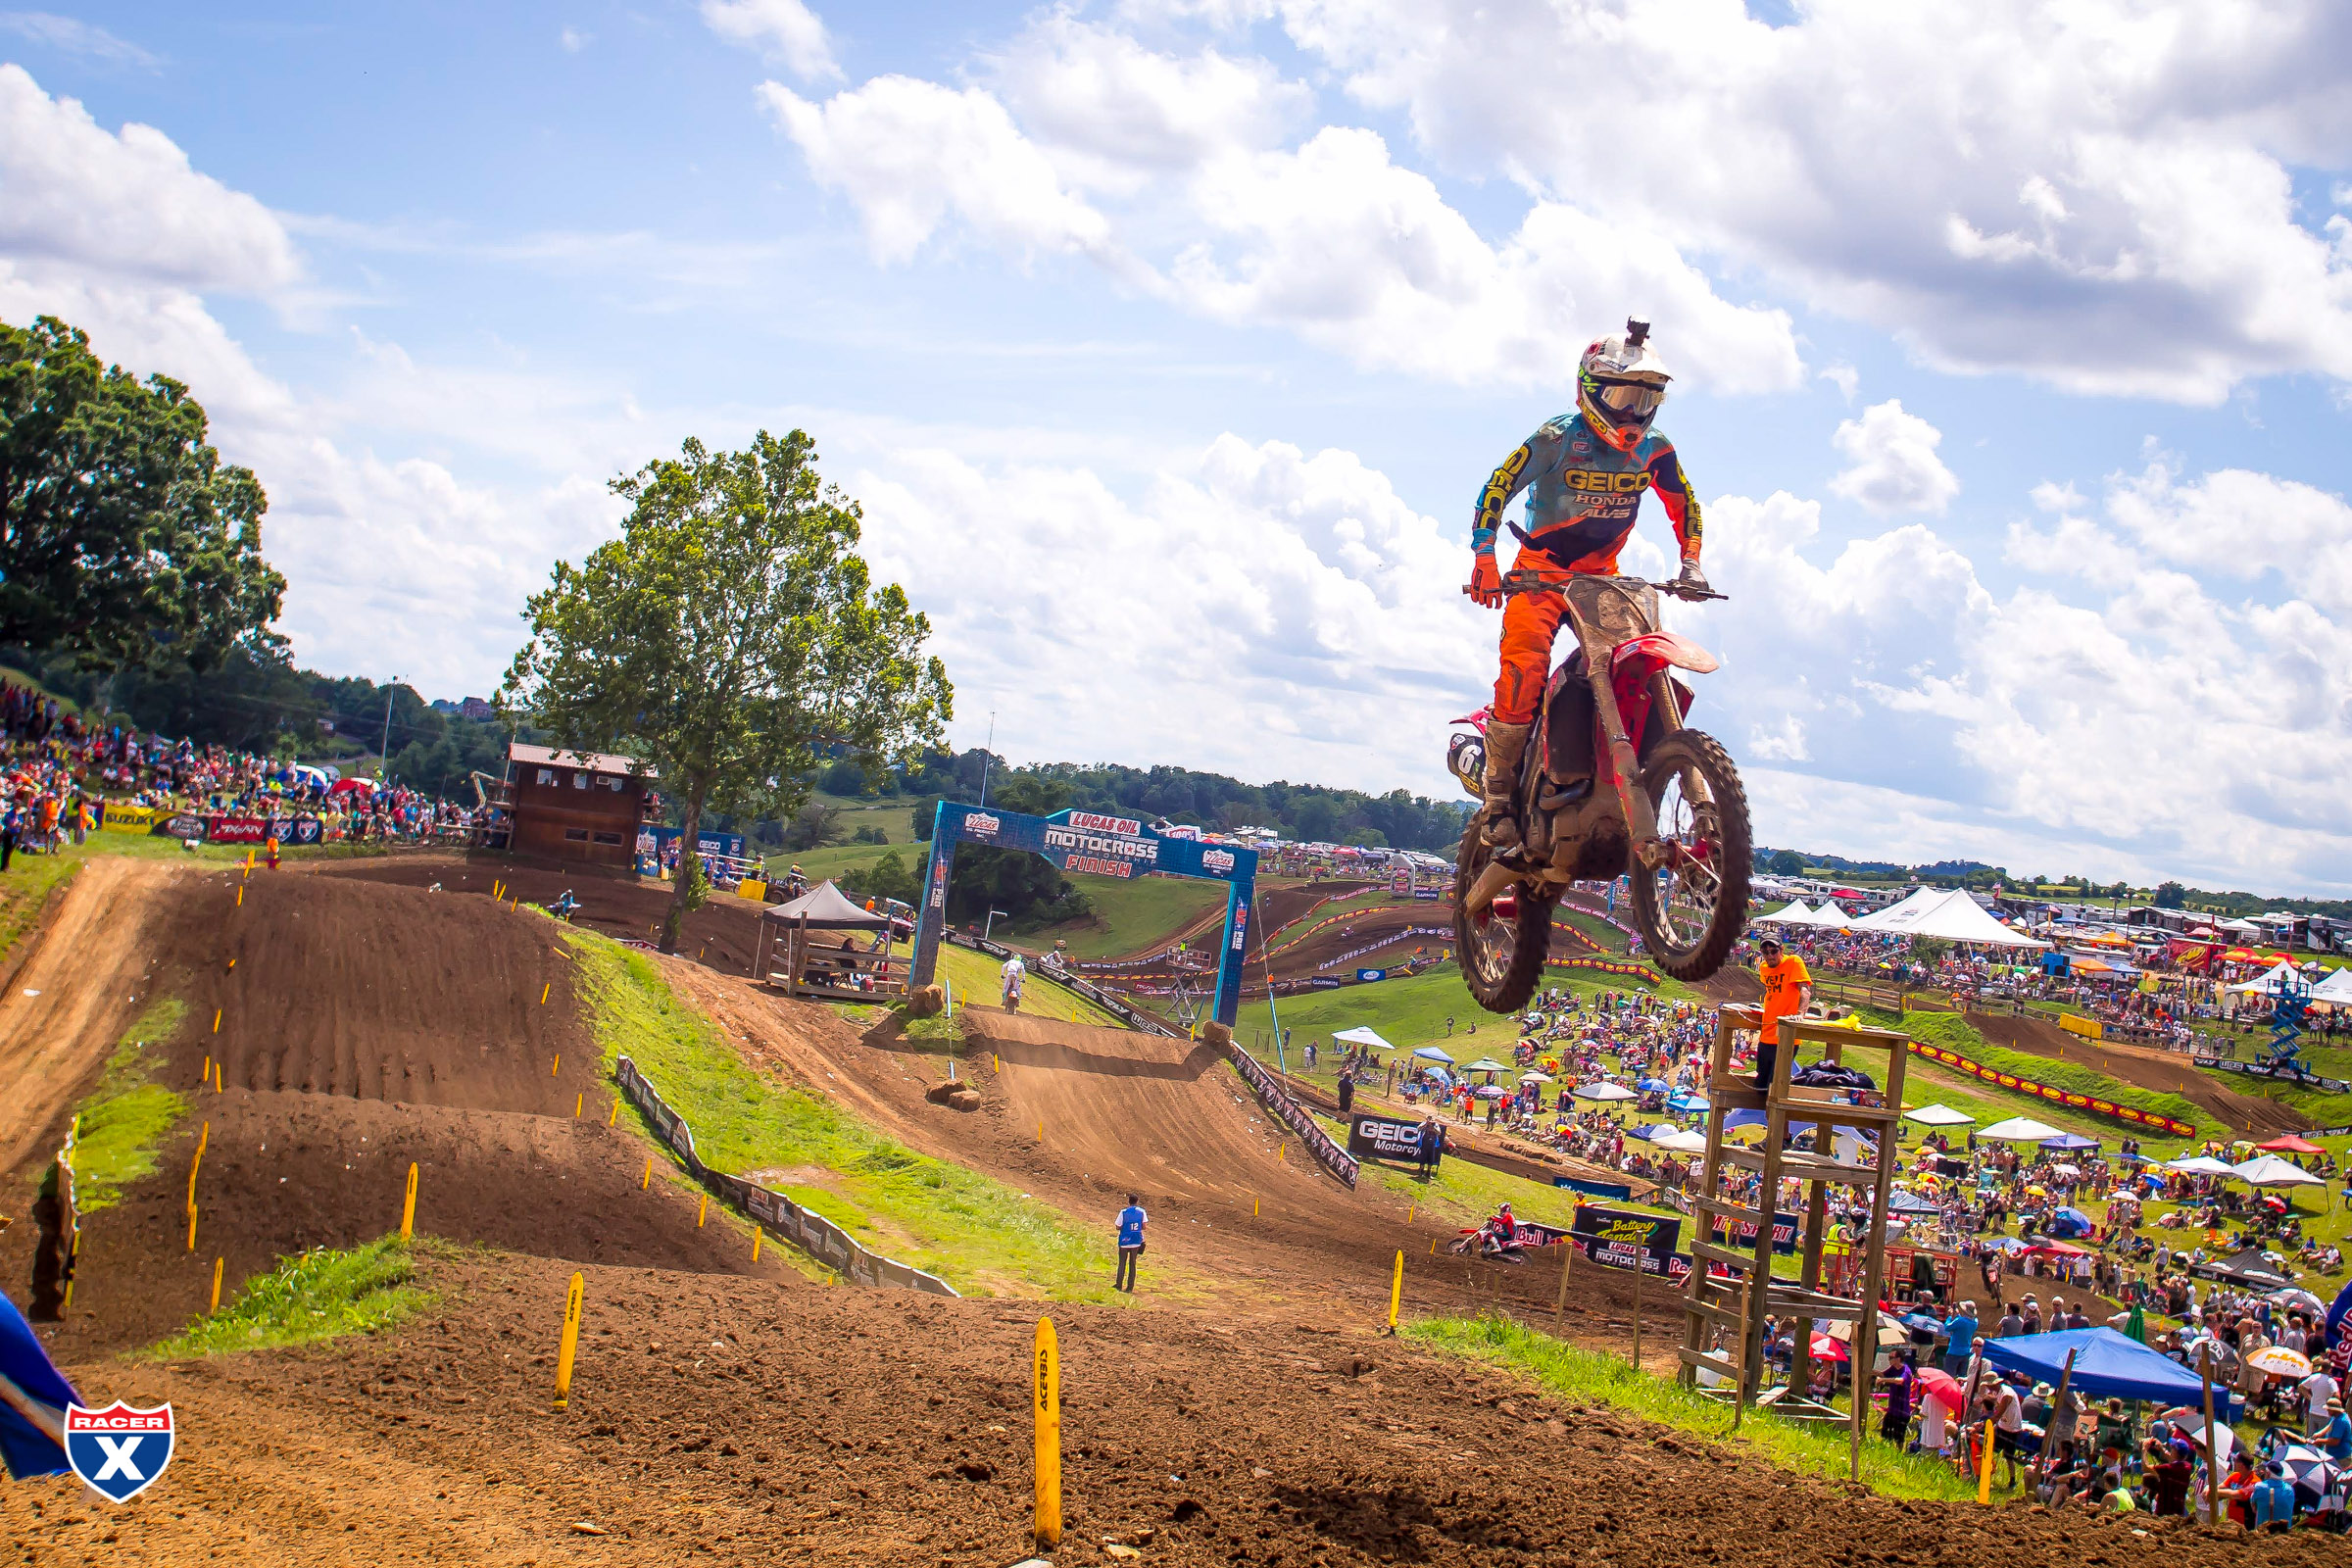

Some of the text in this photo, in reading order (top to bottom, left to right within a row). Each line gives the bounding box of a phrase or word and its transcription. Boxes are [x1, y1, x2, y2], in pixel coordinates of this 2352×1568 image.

[1565, 469, 1652, 492] GEICO
[1575, 494, 1637, 506] HONDA
[969, 819, 998, 830] LUCAS
[1072, 813, 1139, 834] LUCAS OIL
[699, 840, 720, 850] GEICO
[1045, 830, 1158, 859] MOTOCROSS
[1066, 855, 1132, 878] FINISH
[1206, 854, 1233, 865] LUCAS
[1359, 1120, 1420, 1144] GEIC
[1374, 1140, 1421, 1157] Motorcy
[1130, 1222, 1139, 1231] 12
[1611, 1220, 1656, 1232] Battery
[1517, 1227, 1544, 1246] Bull
[1596, 1228, 1647, 1243] Tendr
[1611, 1243, 1636, 1253] LUCAS
[1596, 1251, 1659, 1270] MOTOCOSS
[1669, 1256, 1692, 1273] Re
